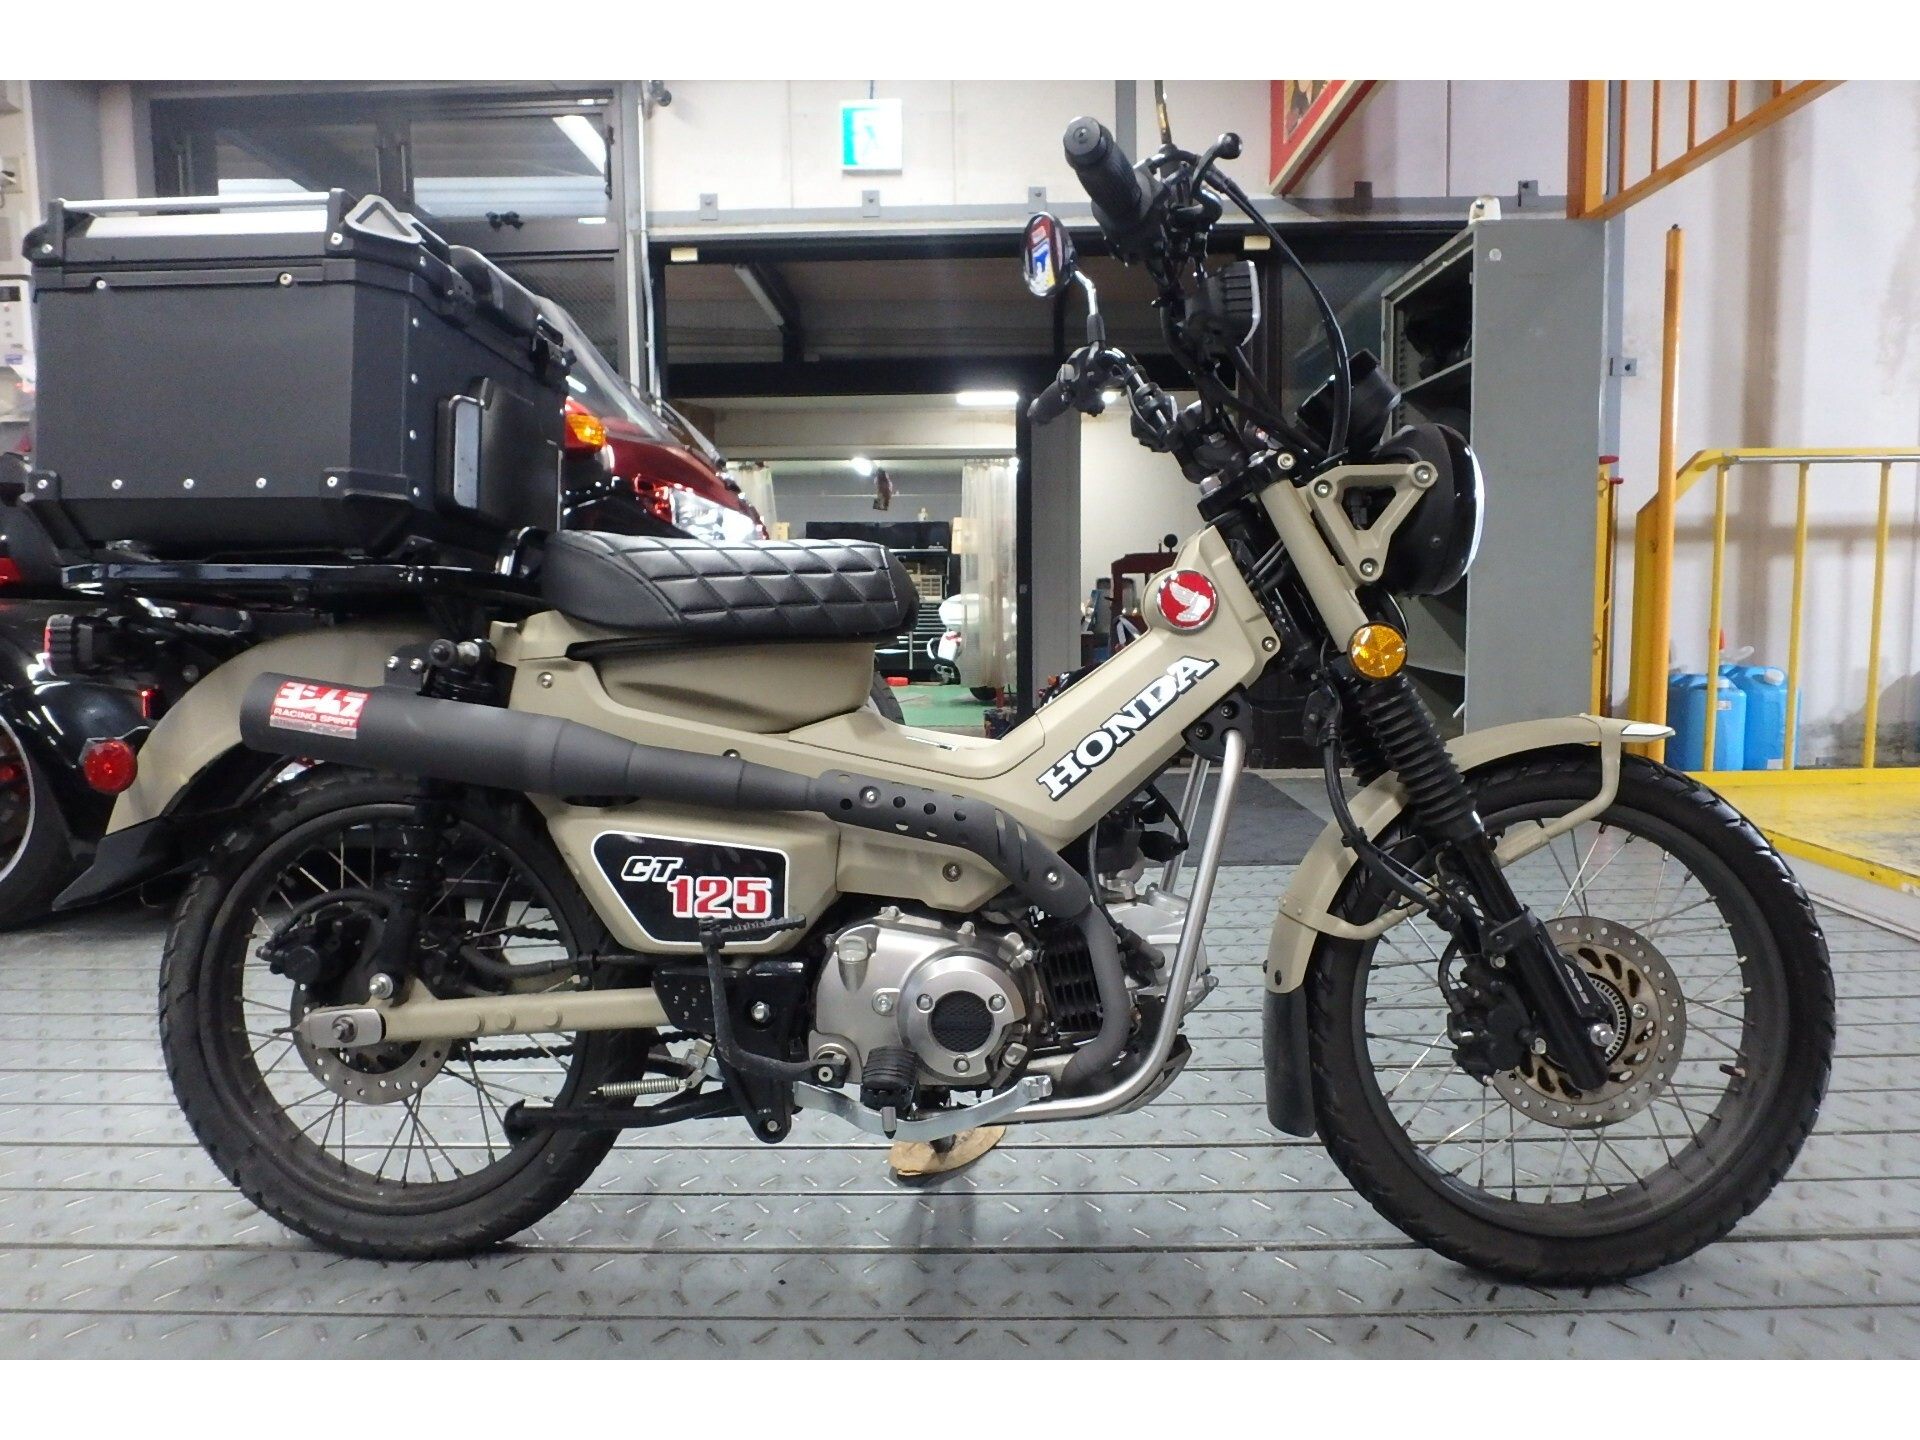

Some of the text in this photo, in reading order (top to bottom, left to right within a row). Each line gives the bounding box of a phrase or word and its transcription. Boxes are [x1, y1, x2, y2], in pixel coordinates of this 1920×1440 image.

[273, 706, 357, 727] RACING SPIRIT
[275, 682, 368, 717] ヨシムラ
[1036, 655, 1220, 801] HONDA
[620, 855, 684, 883] CT
[667, 875, 773, 920] 125
